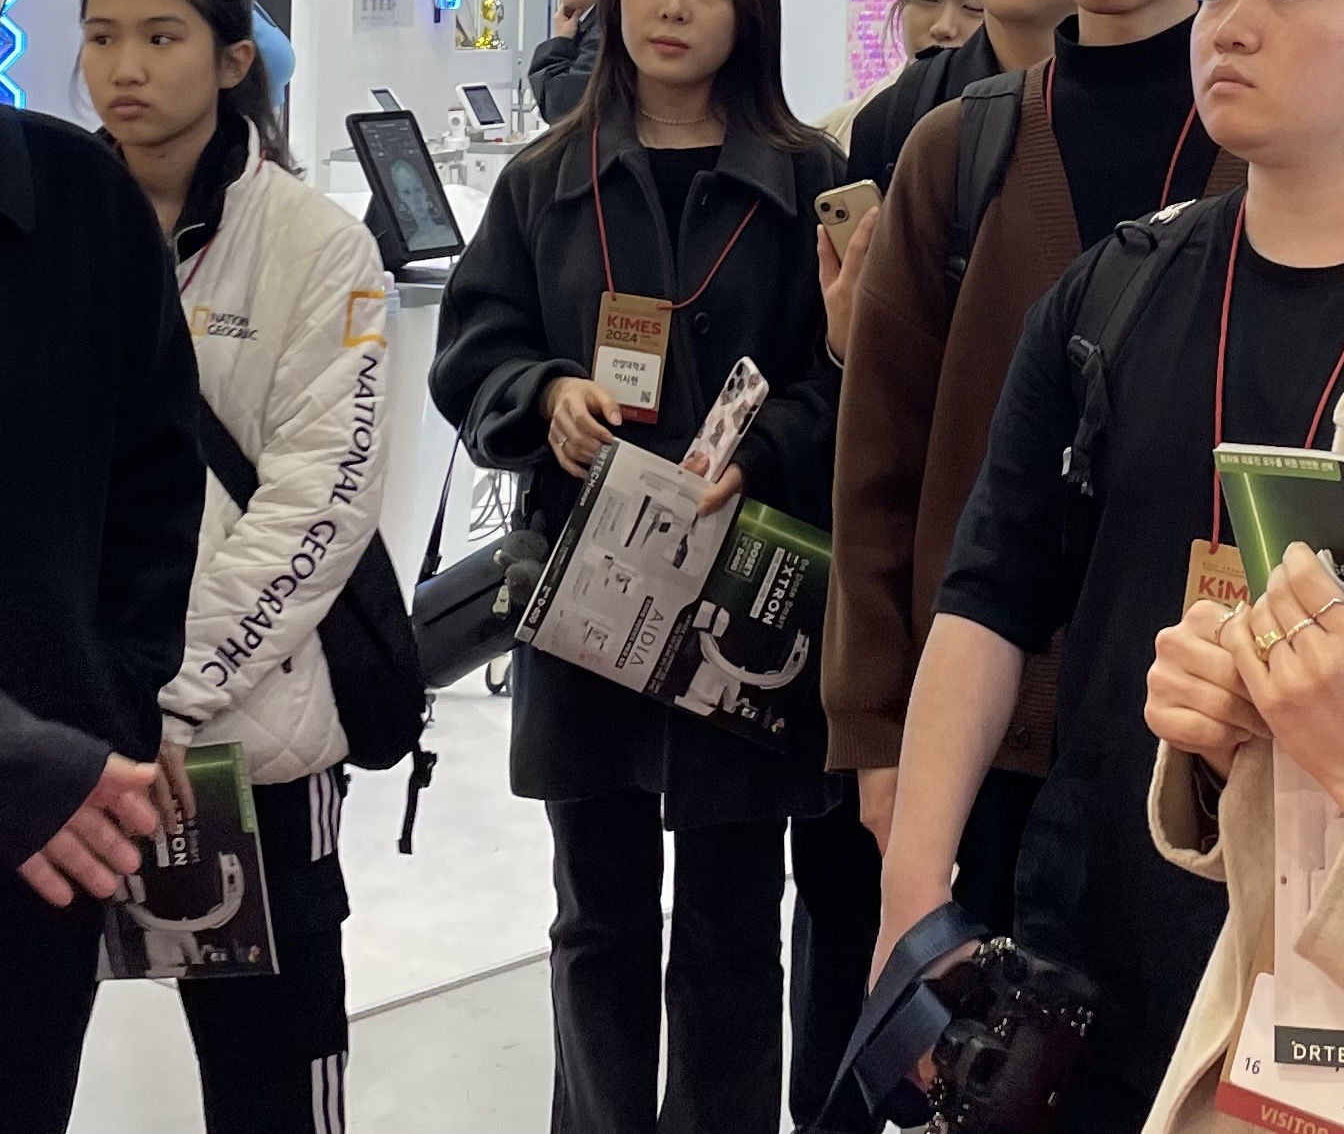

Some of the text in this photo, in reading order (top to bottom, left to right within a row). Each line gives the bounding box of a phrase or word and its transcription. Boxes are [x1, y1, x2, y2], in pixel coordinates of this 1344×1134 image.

[605, 329, 638, 344] 2024
[200, 354, 380, 688] NATIONAL GEOGRAPHIC
[1243, 1056, 1262, 1076] 16
